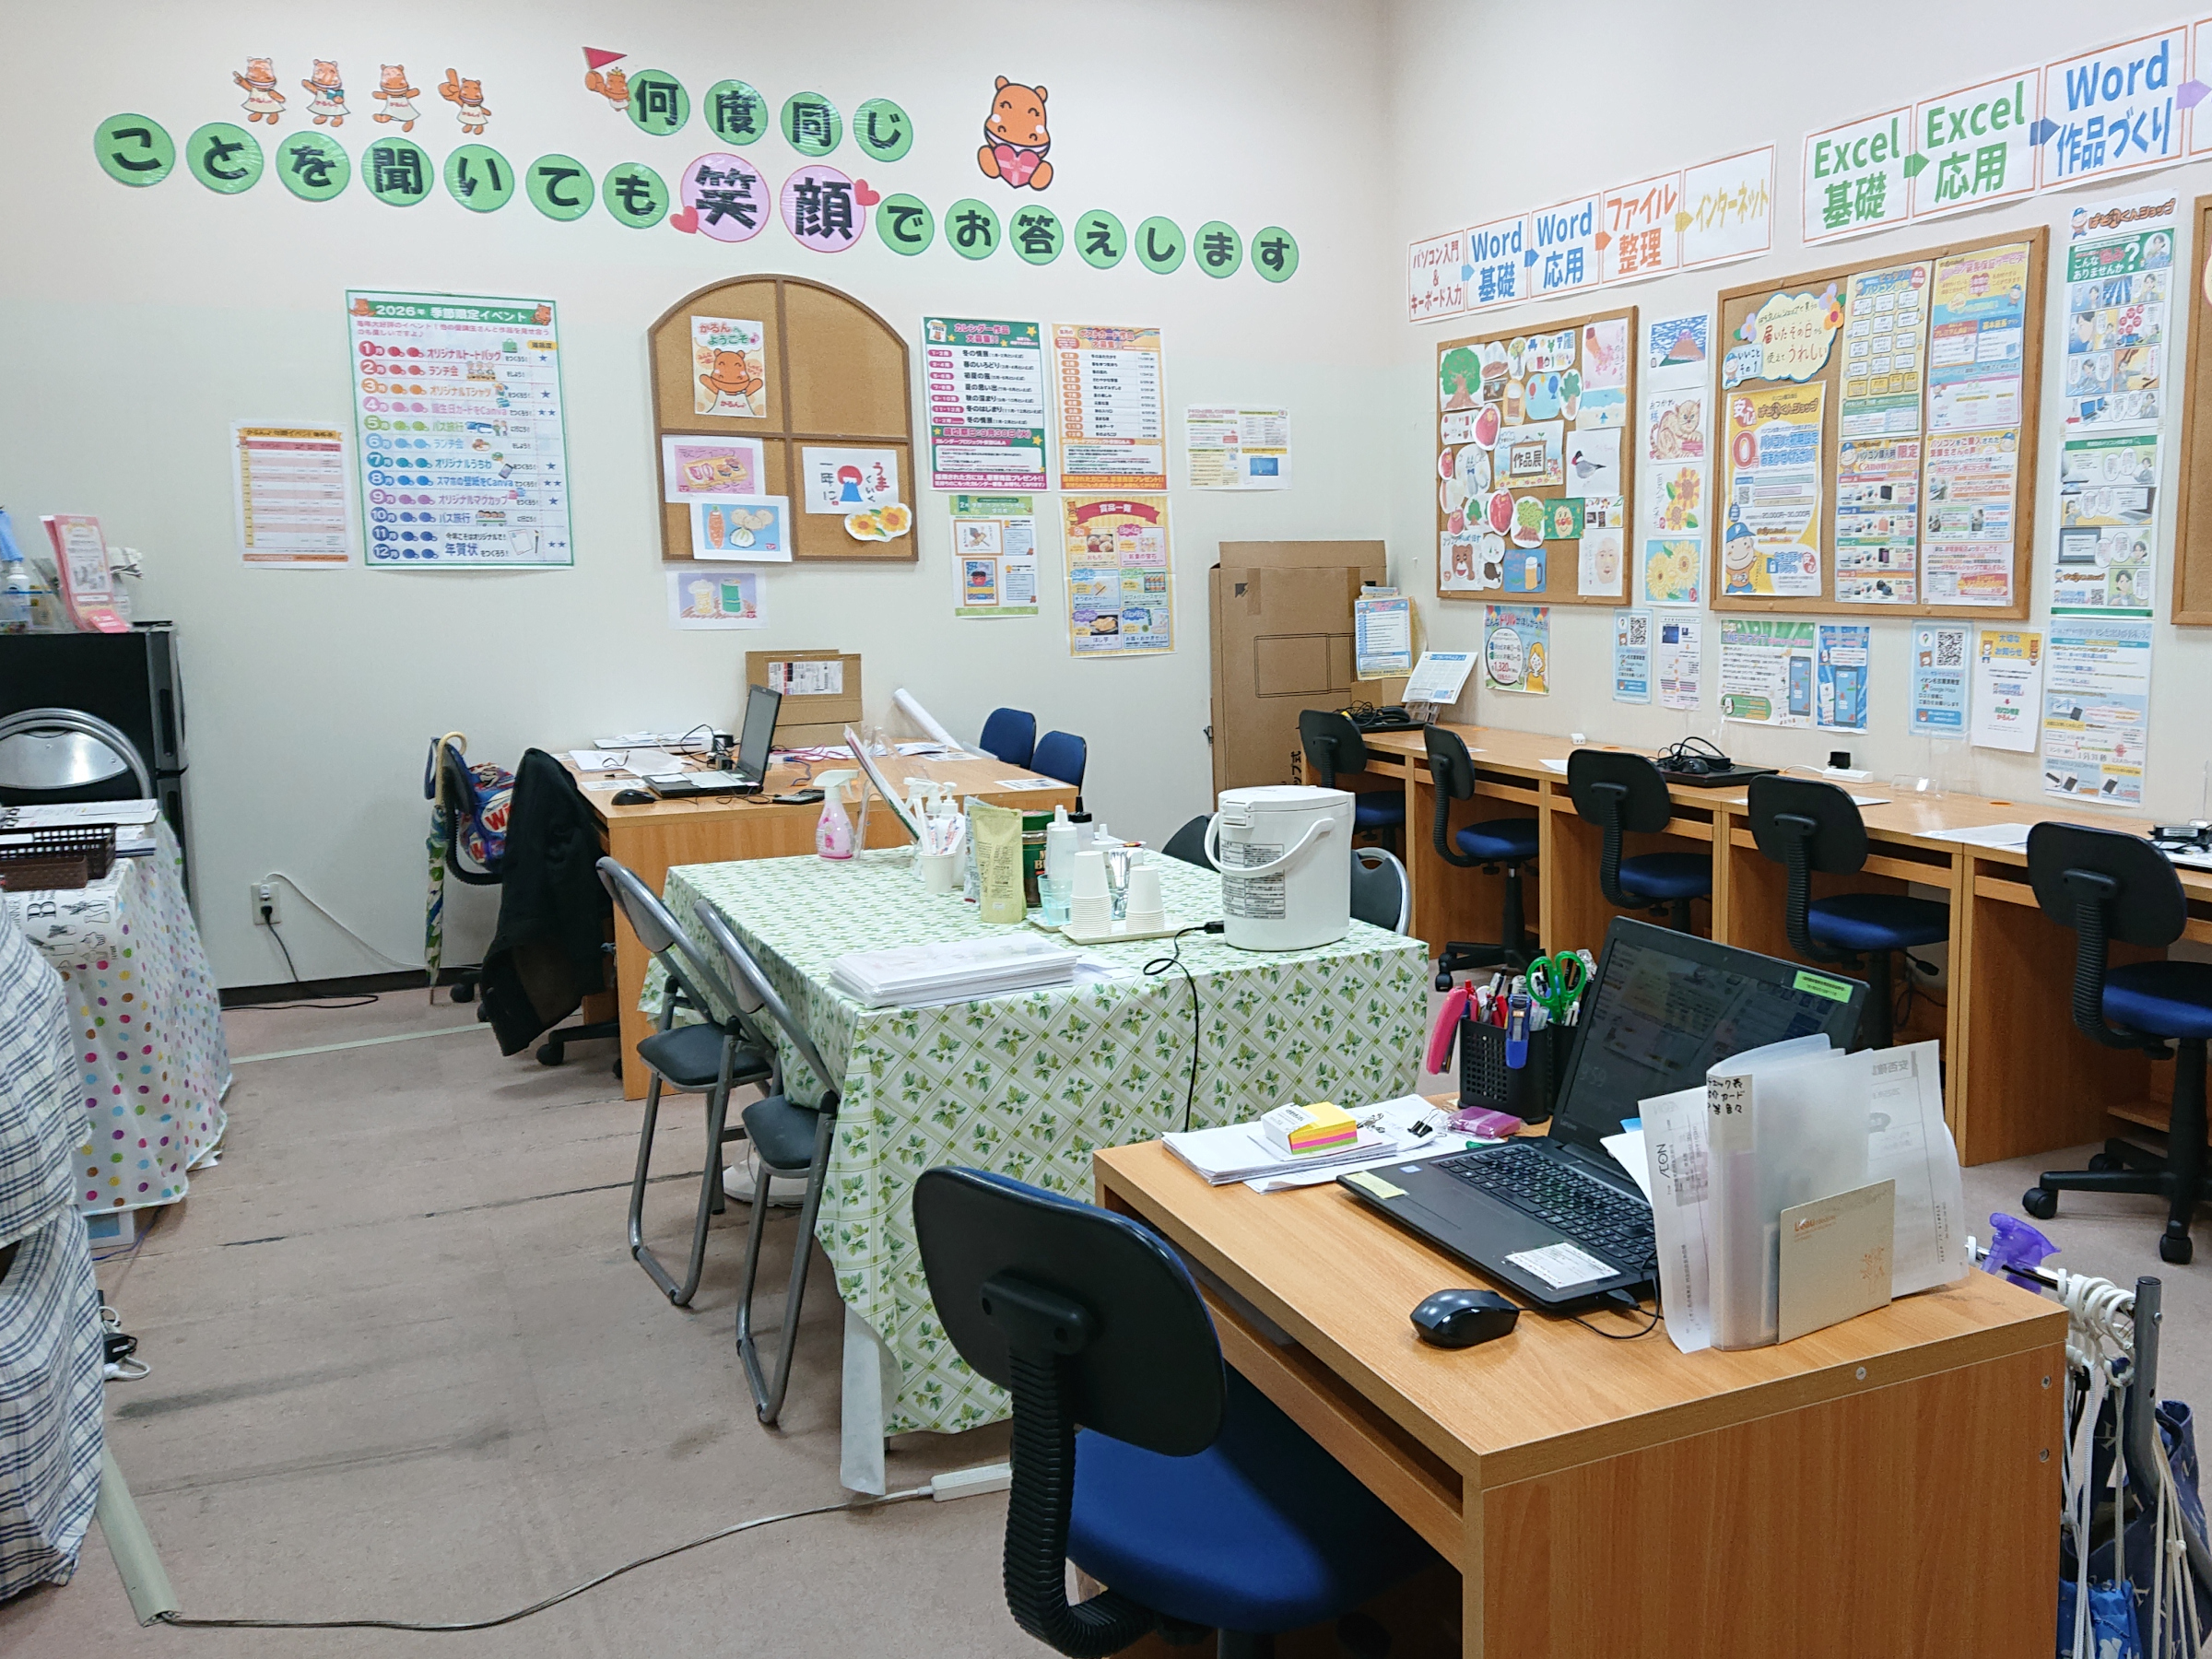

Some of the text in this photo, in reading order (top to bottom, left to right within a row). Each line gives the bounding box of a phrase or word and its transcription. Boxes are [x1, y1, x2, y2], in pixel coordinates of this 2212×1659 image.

[2065, 39, 2171, 112] Word
[634, 76, 901, 147] 何度同じ
[1926, 80, 2026, 149] Excel
[1814, 117, 1900, 180] Excel
[2056, 97, 2173, 177] 作品づくり
[1935, 141, 2008, 204] 応用
[1606, 182, 1678, 231] ファイル
[1694, 178, 1769, 232] インターネット
[1822, 171, 1888, 229] 基礎
[1471, 221, 1523, 264] Word
[1536, 201, 1593, 248] Word
[1412, 239, 1460, 269] パソコン入門
[1542, 246, 1584, 290] 応用
[1618, 227, 1663, 275] 整理
[2072, 263, 2124, 281] ありませんか
[1410, 283, 1463, 311] キーボード入力
[1432, 270, 1440, 285] &
[1477, 261, 1517, 302] 基礎
[707, 334, 748, 347] ようこそ
[429, 366, 459, 377] ランチ会
[1513, 449, 1543, 468] 作品展
[444, 542, 478, 557] 年賀状
[1994, 647, 2023, 657] お知らせ
